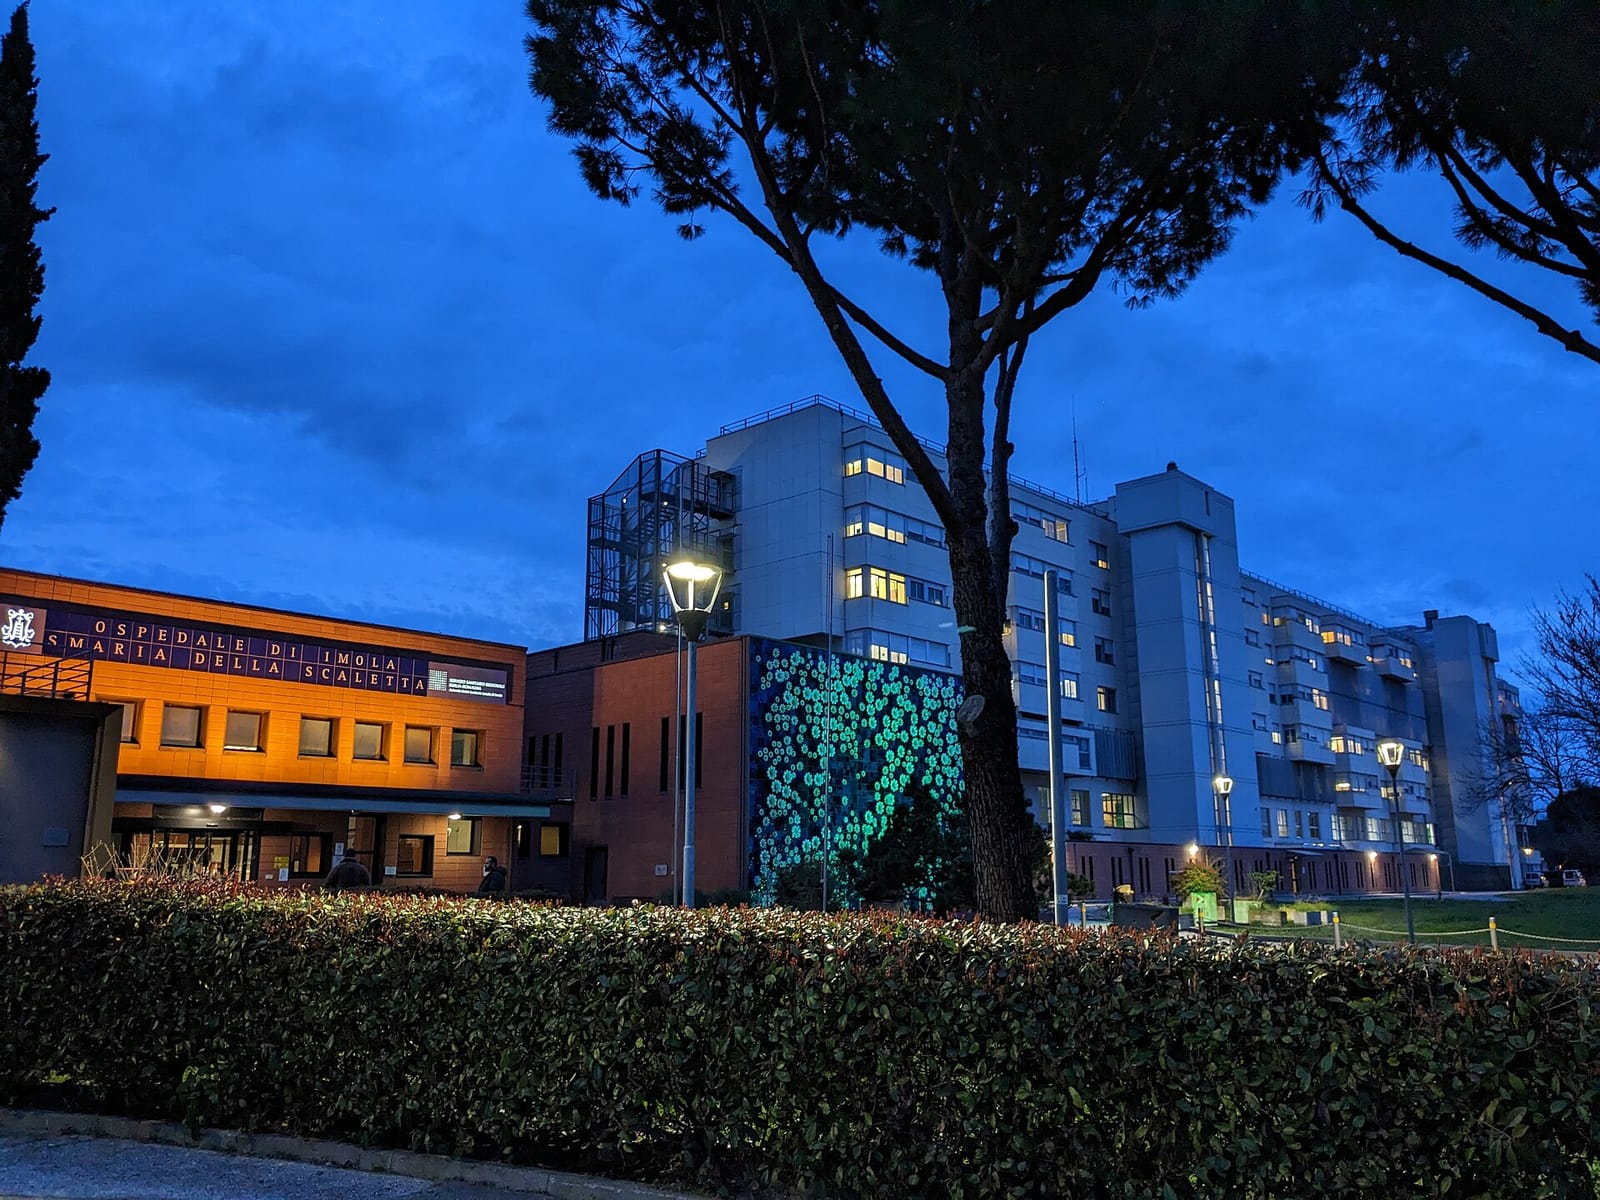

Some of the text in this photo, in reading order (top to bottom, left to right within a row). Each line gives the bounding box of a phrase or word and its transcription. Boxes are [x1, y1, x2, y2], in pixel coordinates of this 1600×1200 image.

[95, 620, 396, 670] OSPEDALE DI IMOLA
[195, 652, 279, 673] DELLA
[304, 665, 424, 690] SCALETTA
